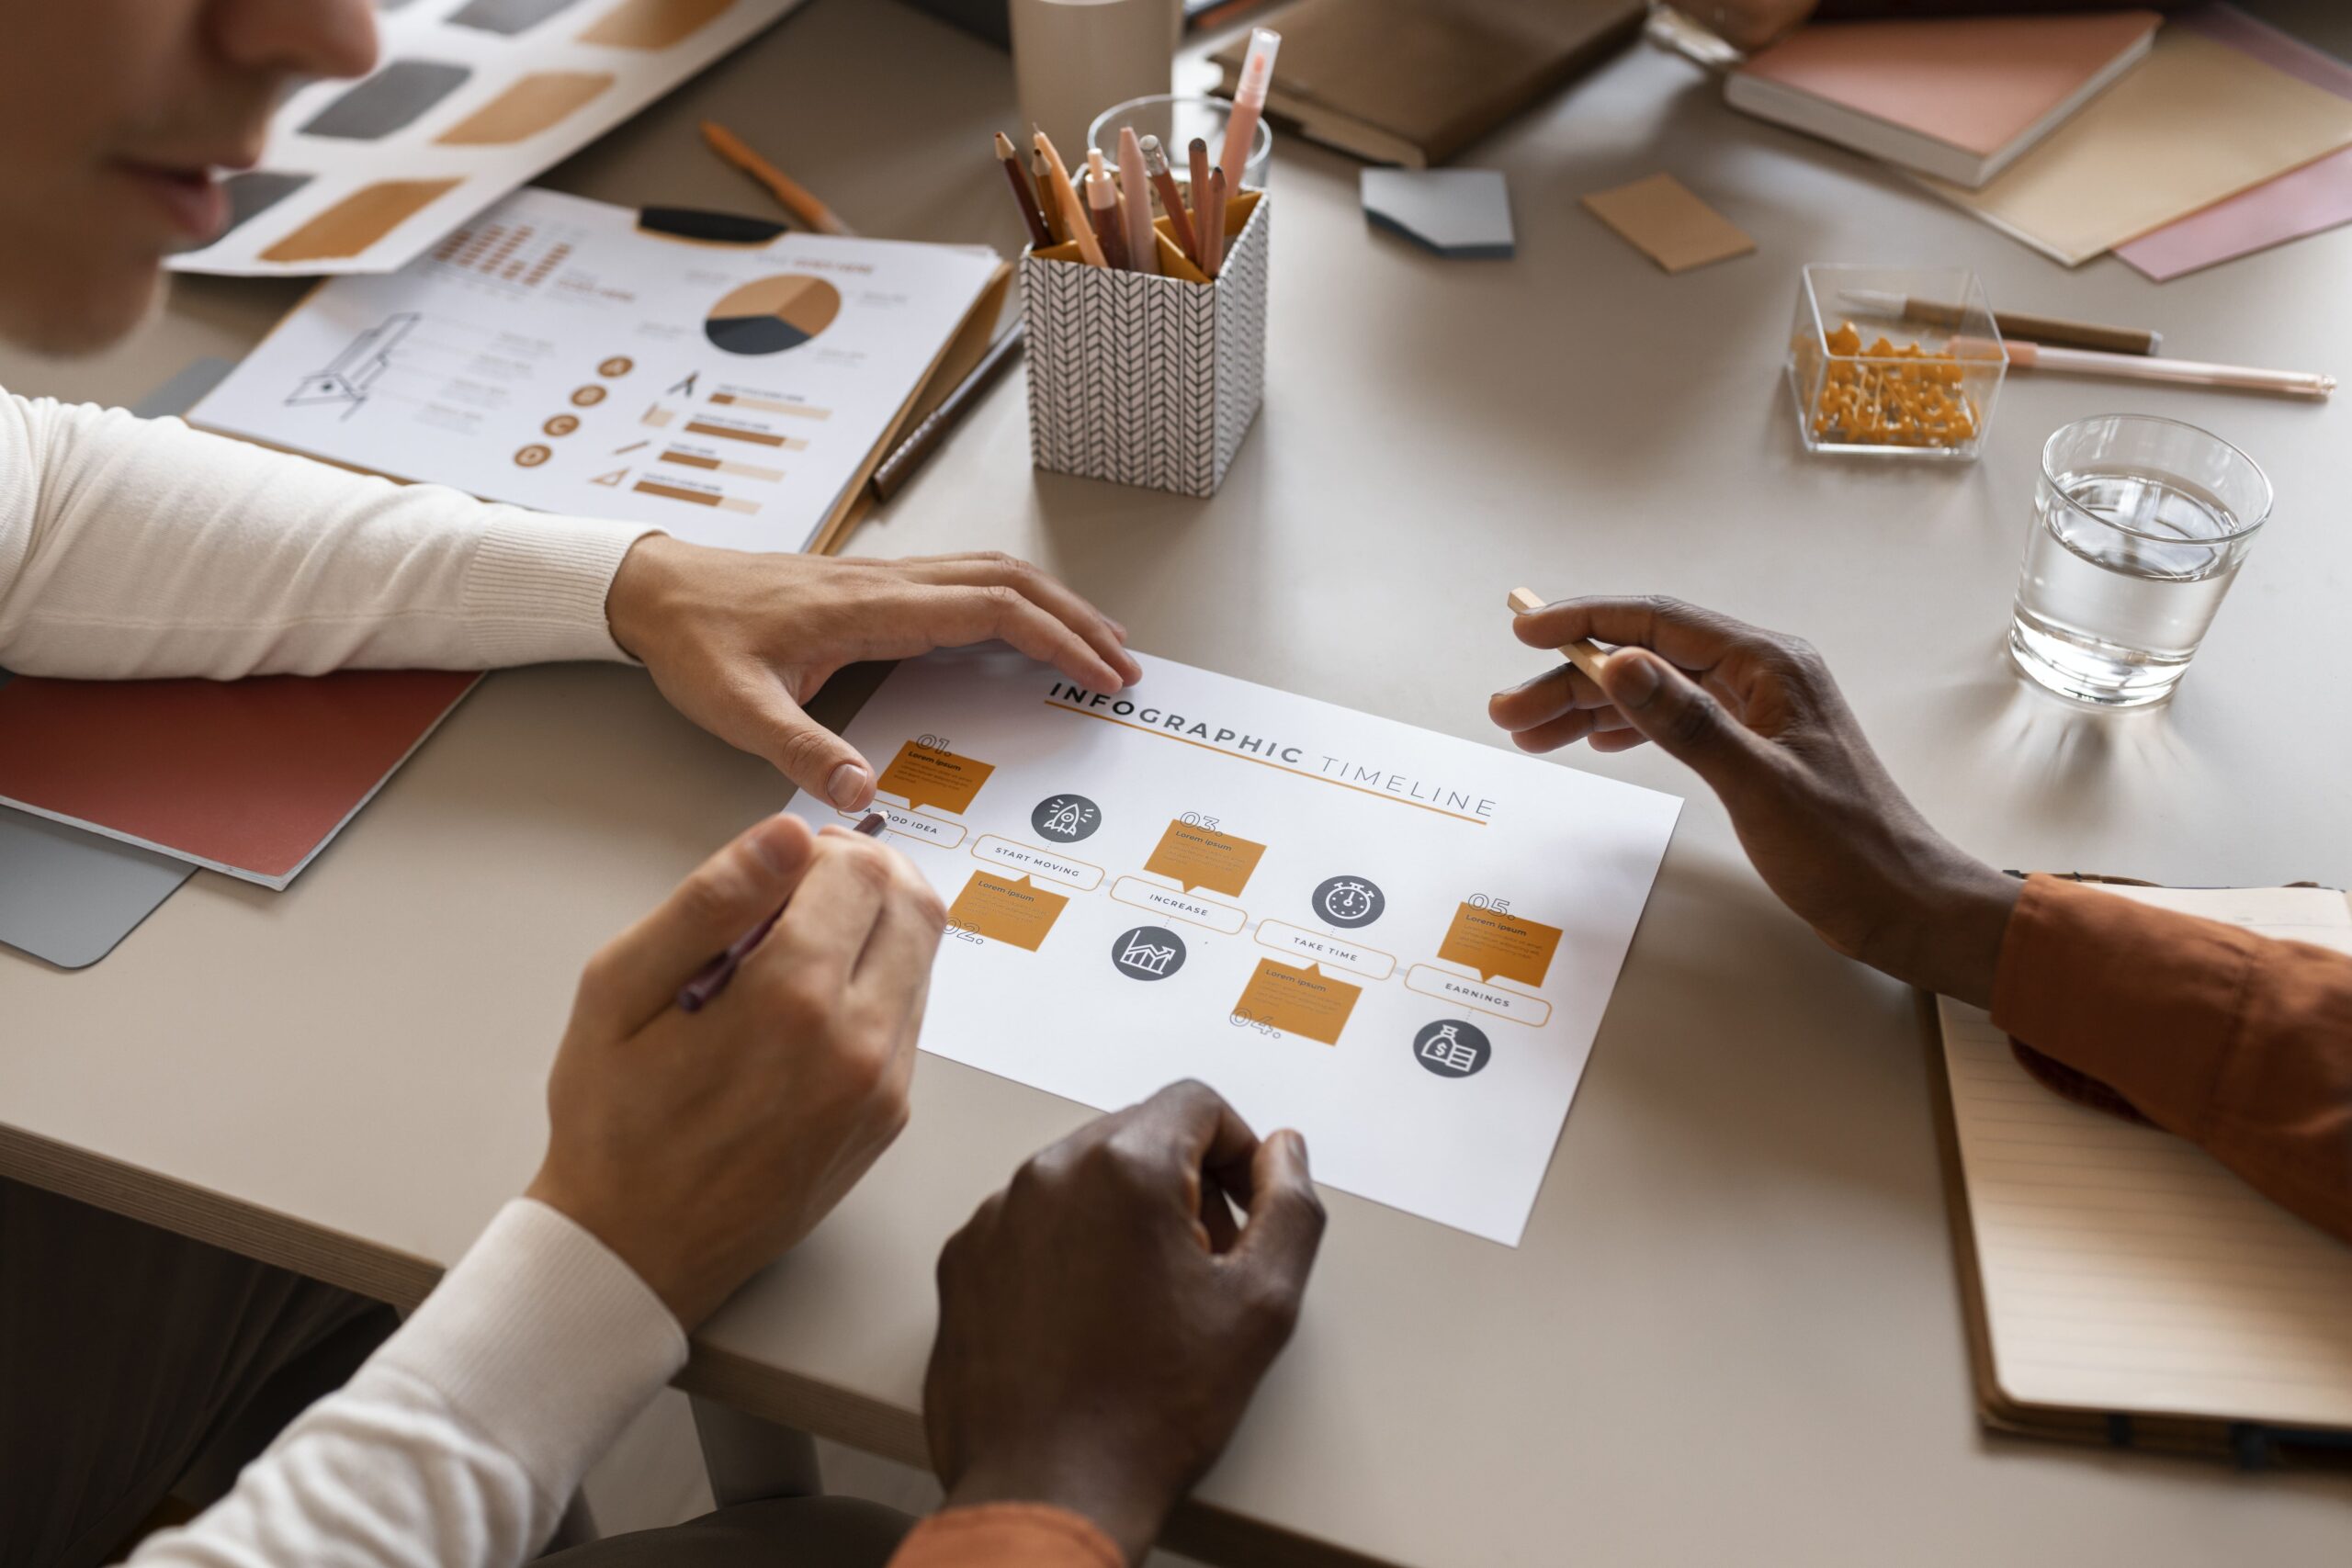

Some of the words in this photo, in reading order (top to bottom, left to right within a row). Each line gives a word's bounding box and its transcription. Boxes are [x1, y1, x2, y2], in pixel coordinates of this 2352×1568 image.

[916, 734, 952, 757] 01.
[1048, 682, 1304, 764] INFOGRAPHIC
[1320, 755, 1497, 818] TIMELINE
[908, 750, 933, 764] Lorem
[934, 759, 961, 772] ipsum
[911, 821, 937, 834] IDEA
[1180, 811, 1223, 837] 03.
[1176, 830, 1203, 843] Lorem
[1204, 840, 1232, 852] ipsum
[995, 847, 1031, 862] START
[1034, 859, 1080, 877] MOVING
[978, 880, 1006, 894] Lorem
[1007, 889, 1035, 902] ipsum
[1149, 894, 1208, 916] INCREASE
[1467, 893, 1516, 921] 05.
[942, 917, 984, 945] 02.
[1465, 914, 1496, 927] Lorem
[1498, 923, 1527, 937] ipsum
[1294, 937, 1323, 952] TAKE
[1329, 947, 1358, 962] TIME
[1265, 969, 1295, 983] Lorem
[1296, 978, 1327, 992] ipsum
[1445, 983, 1510, 1008] EARNINGS
[1229, 1008, 1281, 1039] 04.
